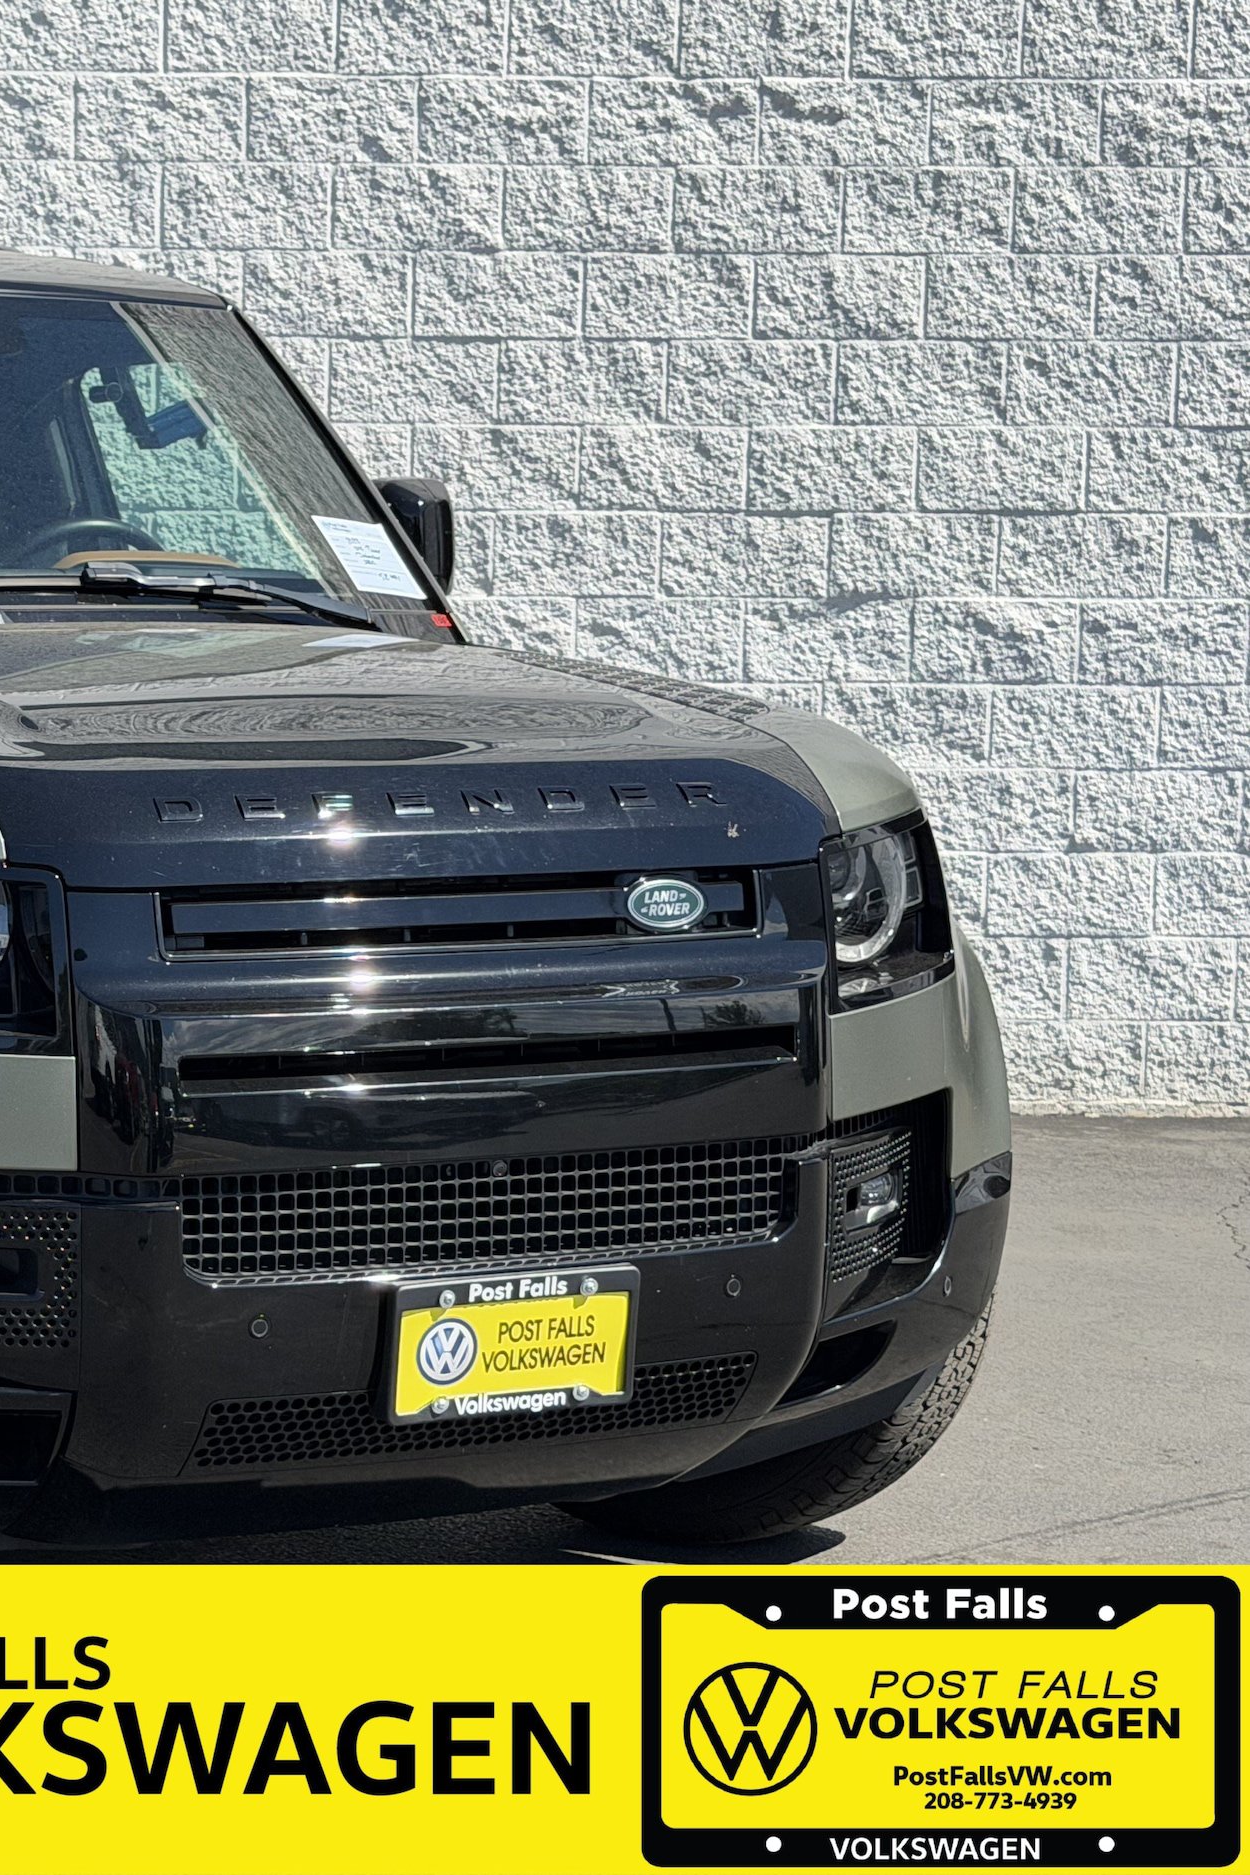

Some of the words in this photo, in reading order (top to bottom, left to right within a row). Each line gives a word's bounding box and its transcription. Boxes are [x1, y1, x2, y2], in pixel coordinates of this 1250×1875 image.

[152, 781, 728, 823] DEFENDER
[644, 890, 678, 904] LAND
[648, 902, 690, 917] ROVER
[468, 1282, 514, 1303] Post
[518, 1277, 568, 1299] Falls
[497, 1318, 543, 1344] POST
[547, 1314, 595, 1339] FALLS
[482, 1341, 606, 1374] VOLKSWAGEN
[454, 1390, 566, 1416] Volkswagen
